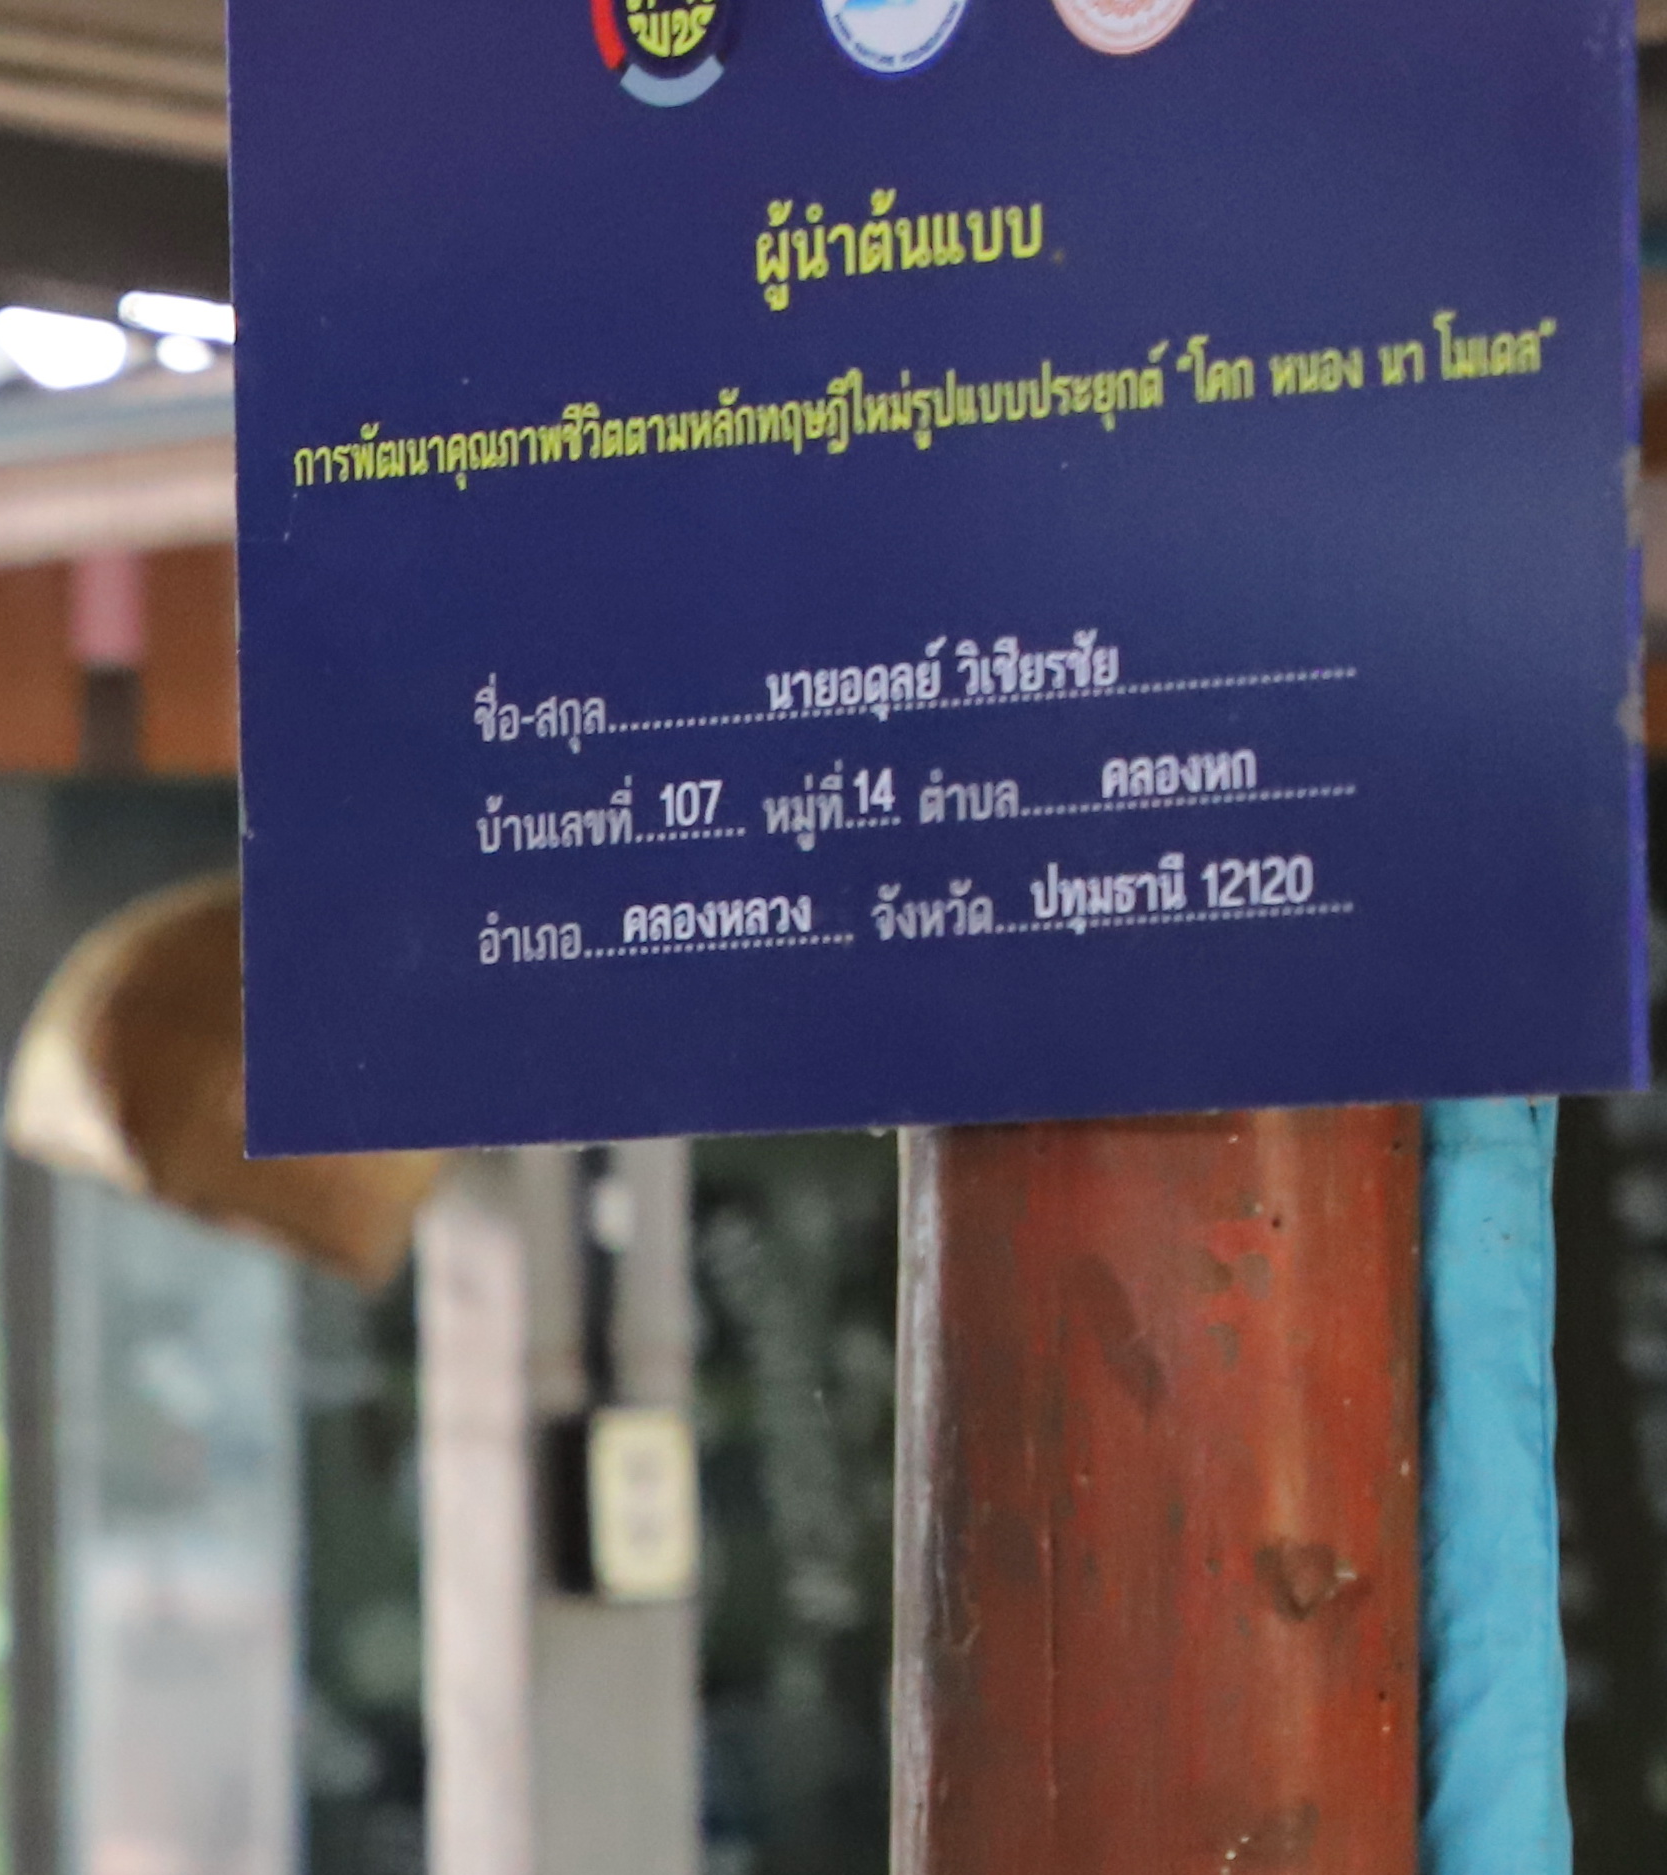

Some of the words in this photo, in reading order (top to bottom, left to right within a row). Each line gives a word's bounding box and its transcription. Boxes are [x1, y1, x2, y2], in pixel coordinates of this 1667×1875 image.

[755, 188, 1043, 312] ผู้นำต้นแบบ
[1269, 346, 1364, 397] หนอง
[1377, 340, 1425, 386] นา
[764, 635, 948, 722] นายอดุลย์
[955, 627, 1120, 697] วิเชียรชัย
[659, 779, 724, 828] 107
[852, 767, 896, 814] 14
[918, 767, 1020, 825] ตำบล
[1100, 748, 1258, 799] คลองหก
[477, 910, 584, 966] อำเภอ
[622, 894, 813, 945] คลองหลวง
[870, 879, 995, 940] จังหวัด
[1029, 851, 1188, 936] ปทุมธานี
[1200, 853, 1315, 909] 12120
